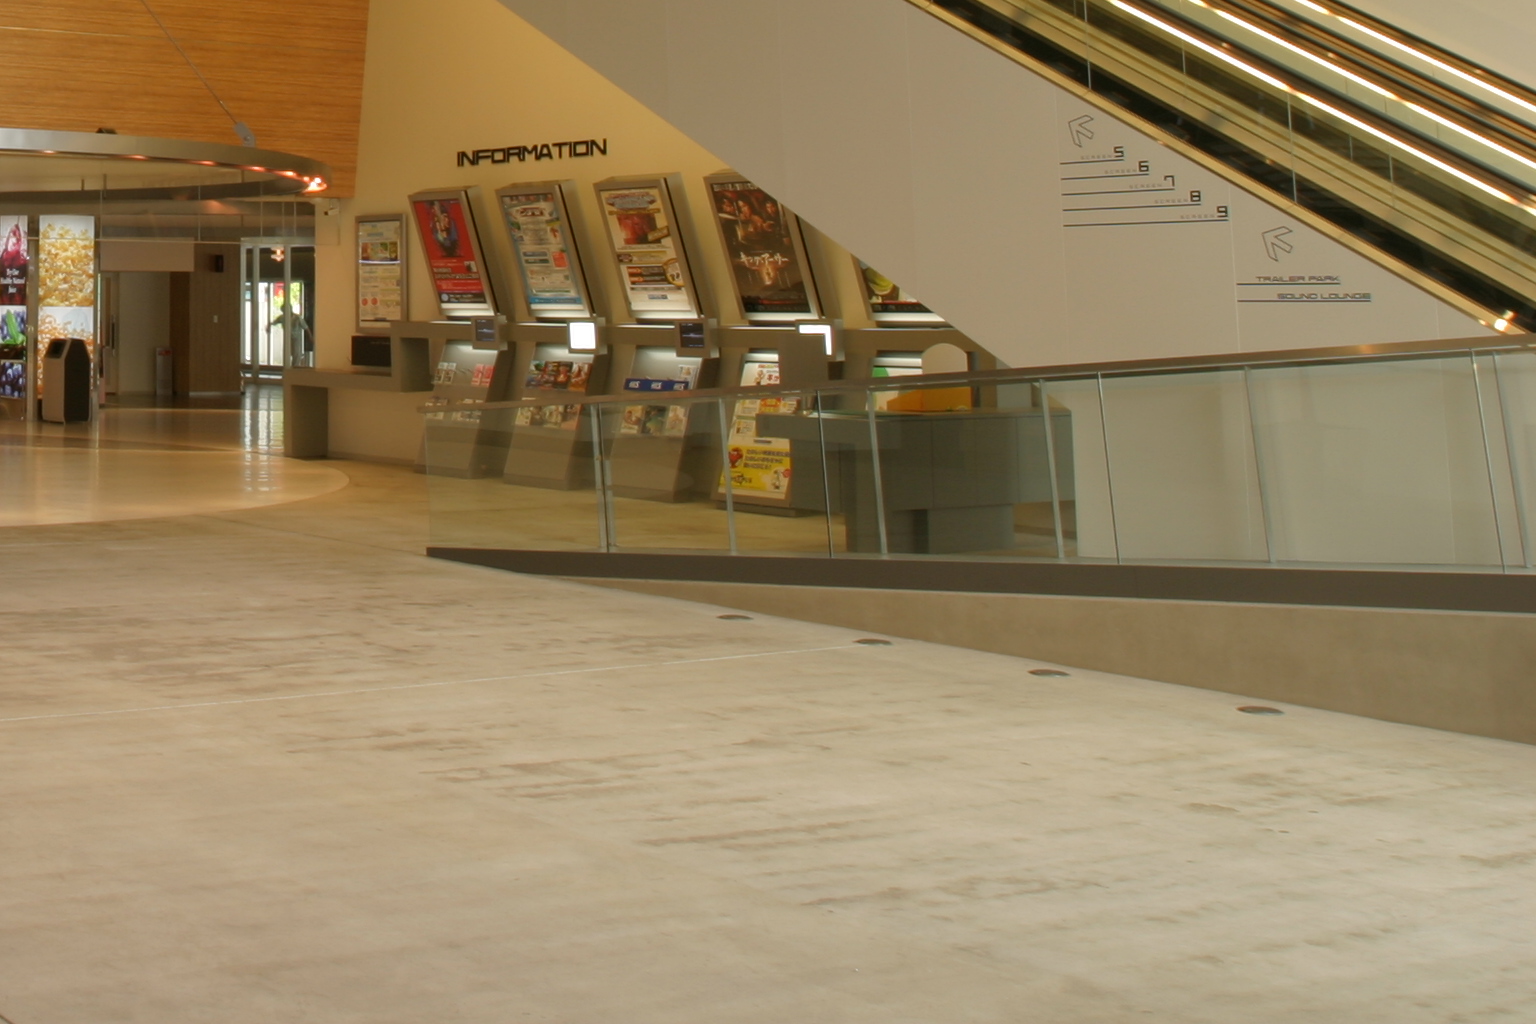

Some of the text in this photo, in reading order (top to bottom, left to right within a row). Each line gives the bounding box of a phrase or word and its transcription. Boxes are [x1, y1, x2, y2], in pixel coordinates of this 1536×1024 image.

[457, 138, 608, 167] INFORMATION
[1113, 146, 1124, 158] 5
[1138, 160, 1149, 173] 6
[1164, 175, 1175, 188] 7
[1190, 190, 1201, 203] 8
[1216, 205, 1228, 218] 9
